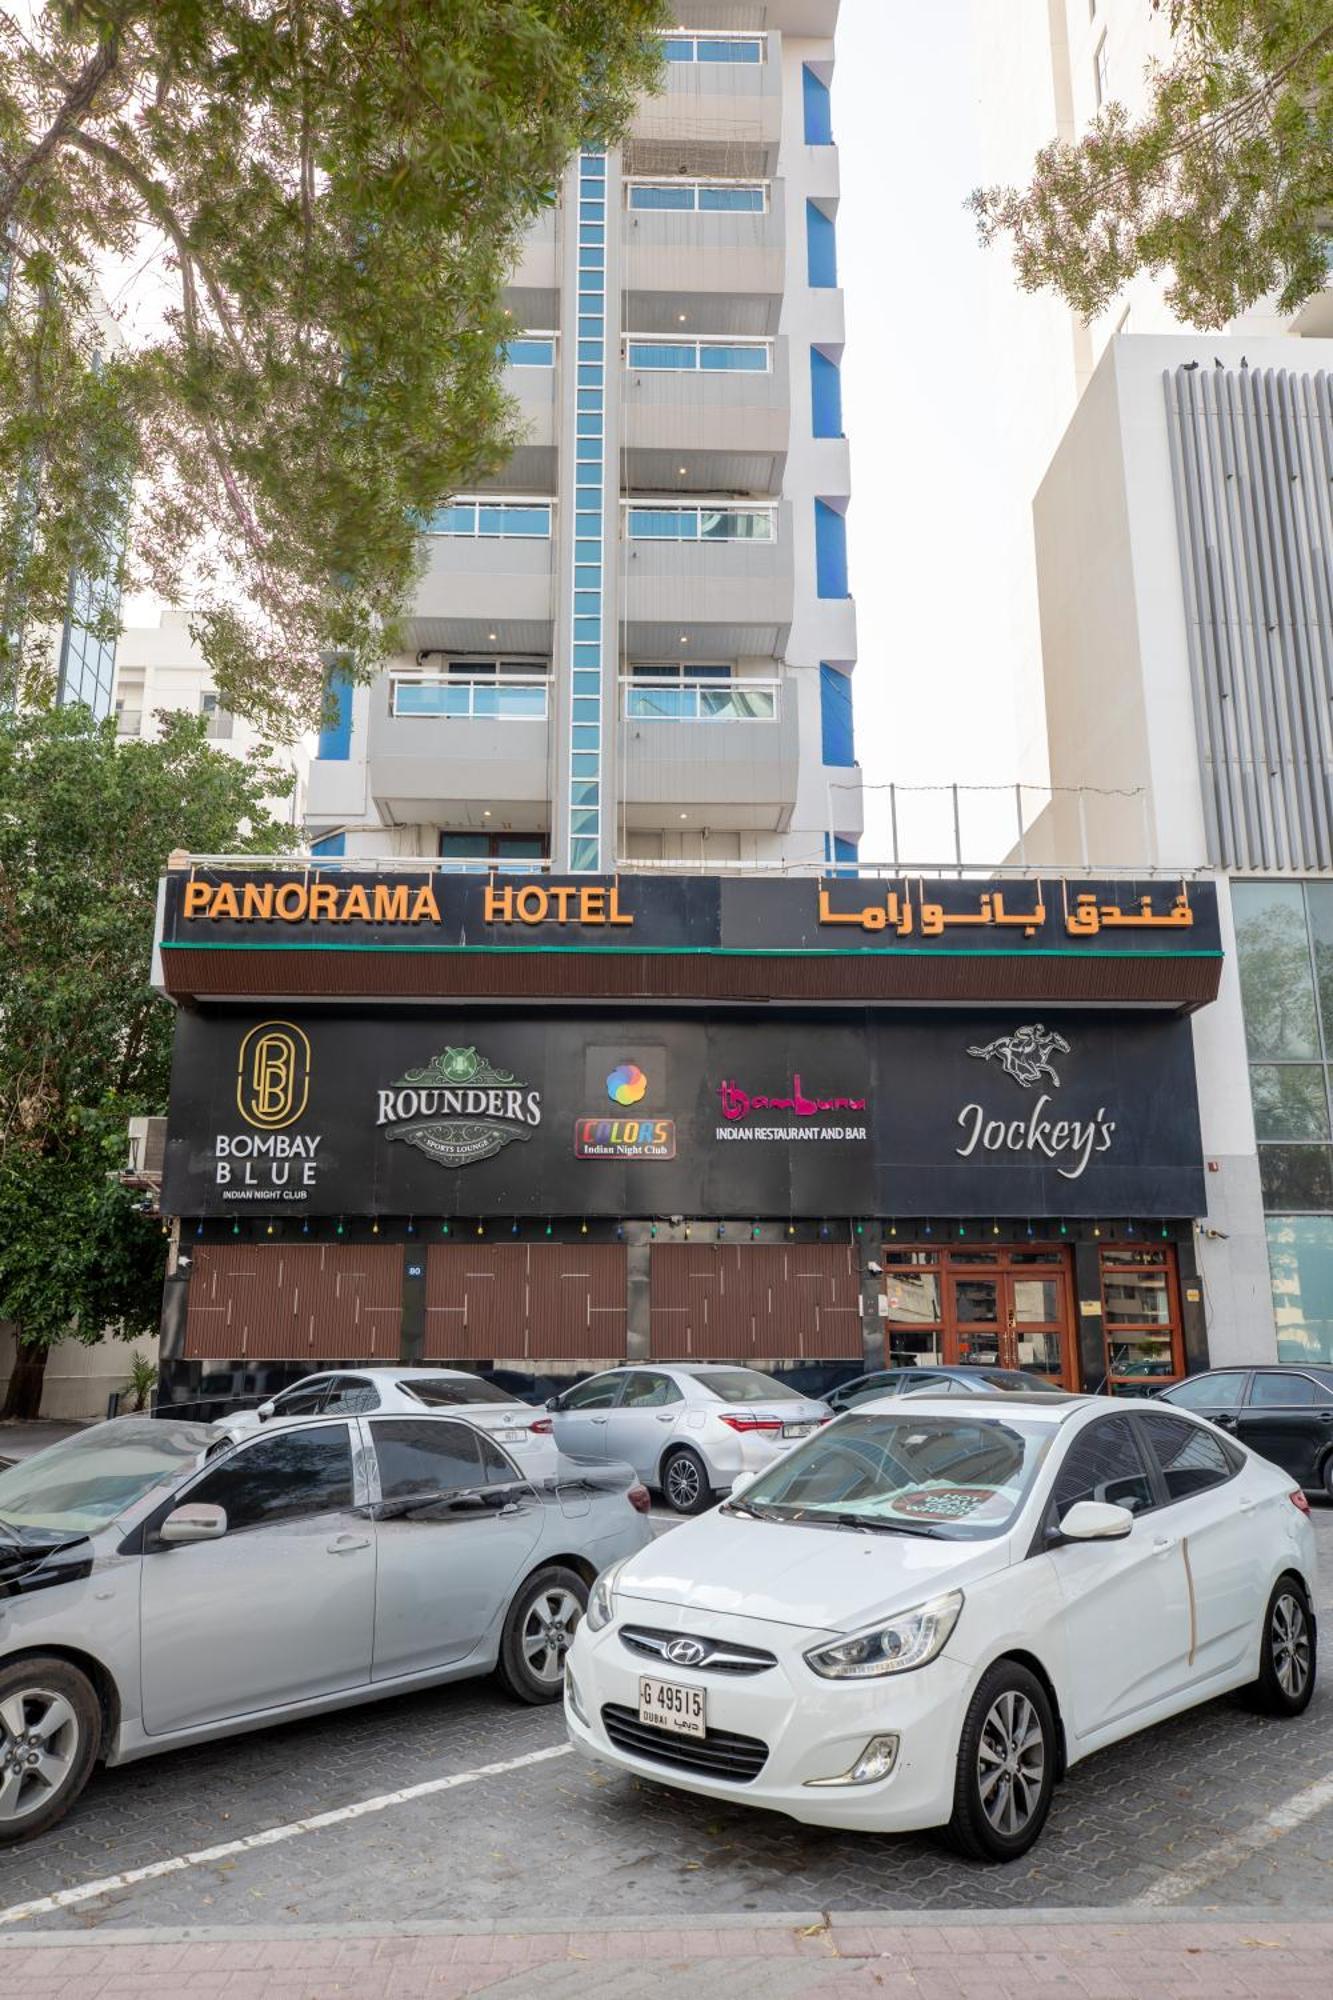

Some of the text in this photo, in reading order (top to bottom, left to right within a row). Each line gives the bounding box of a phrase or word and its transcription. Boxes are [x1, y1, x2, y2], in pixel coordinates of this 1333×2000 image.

[184, 882, 634, 925] PANORAMA HOTEL
[1066, 893, 1194, 936] فندق
[376, 1089, 542, 1126] ROUNDERS
[583, 1120, 669, 1144] COLORS
[716, 1127, 867, 1140] INDIAN RESTAURANT AND BAR
[956, 1094, 1116, 1179] Jockey's
[215, 1135, 322, 1159] BOMBAY
[426, 1138, 489, 1153] SPORTS LOUNGE
[584, 1144, 668, 1157] Indian Night Club
[215, 1161, 317, 1185] BLUE
[223, 1190, 308, 1200] INDIAN NIGHT CLUB
[643, 1683, 701, 1717] G 49515
[643, 1710, 668, 1726] DUBAI
